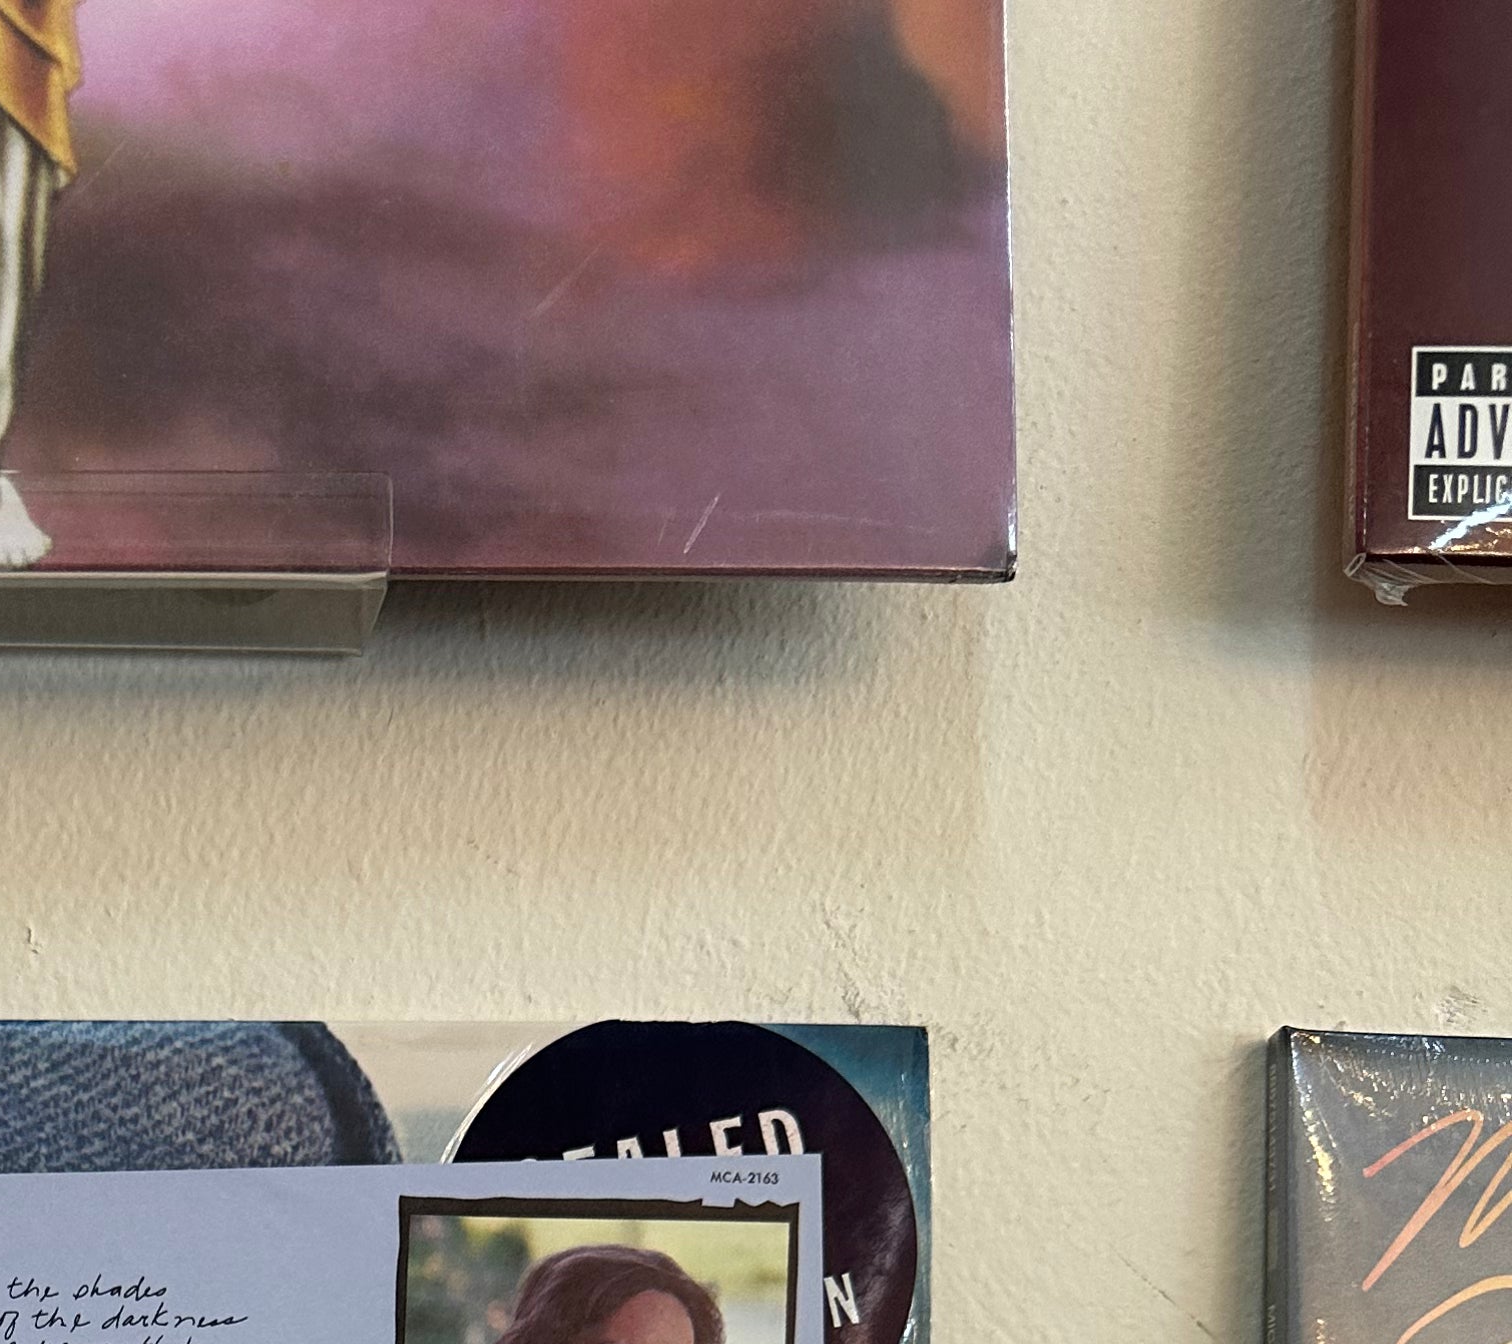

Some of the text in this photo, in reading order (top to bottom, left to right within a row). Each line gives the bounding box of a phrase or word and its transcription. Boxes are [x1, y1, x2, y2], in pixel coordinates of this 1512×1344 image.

[1431, 362, 1508, 391] PAR
[1424, 402, 1511, 460] ADV
[710, 1171, 779, 1185] MCA-2163
[8, 1278, 58, 1301] the
[73, 1274, 168, 1301] shades
[32, 1307, 90, 1329] the
[101, 1303, 248, 1330] darkness
